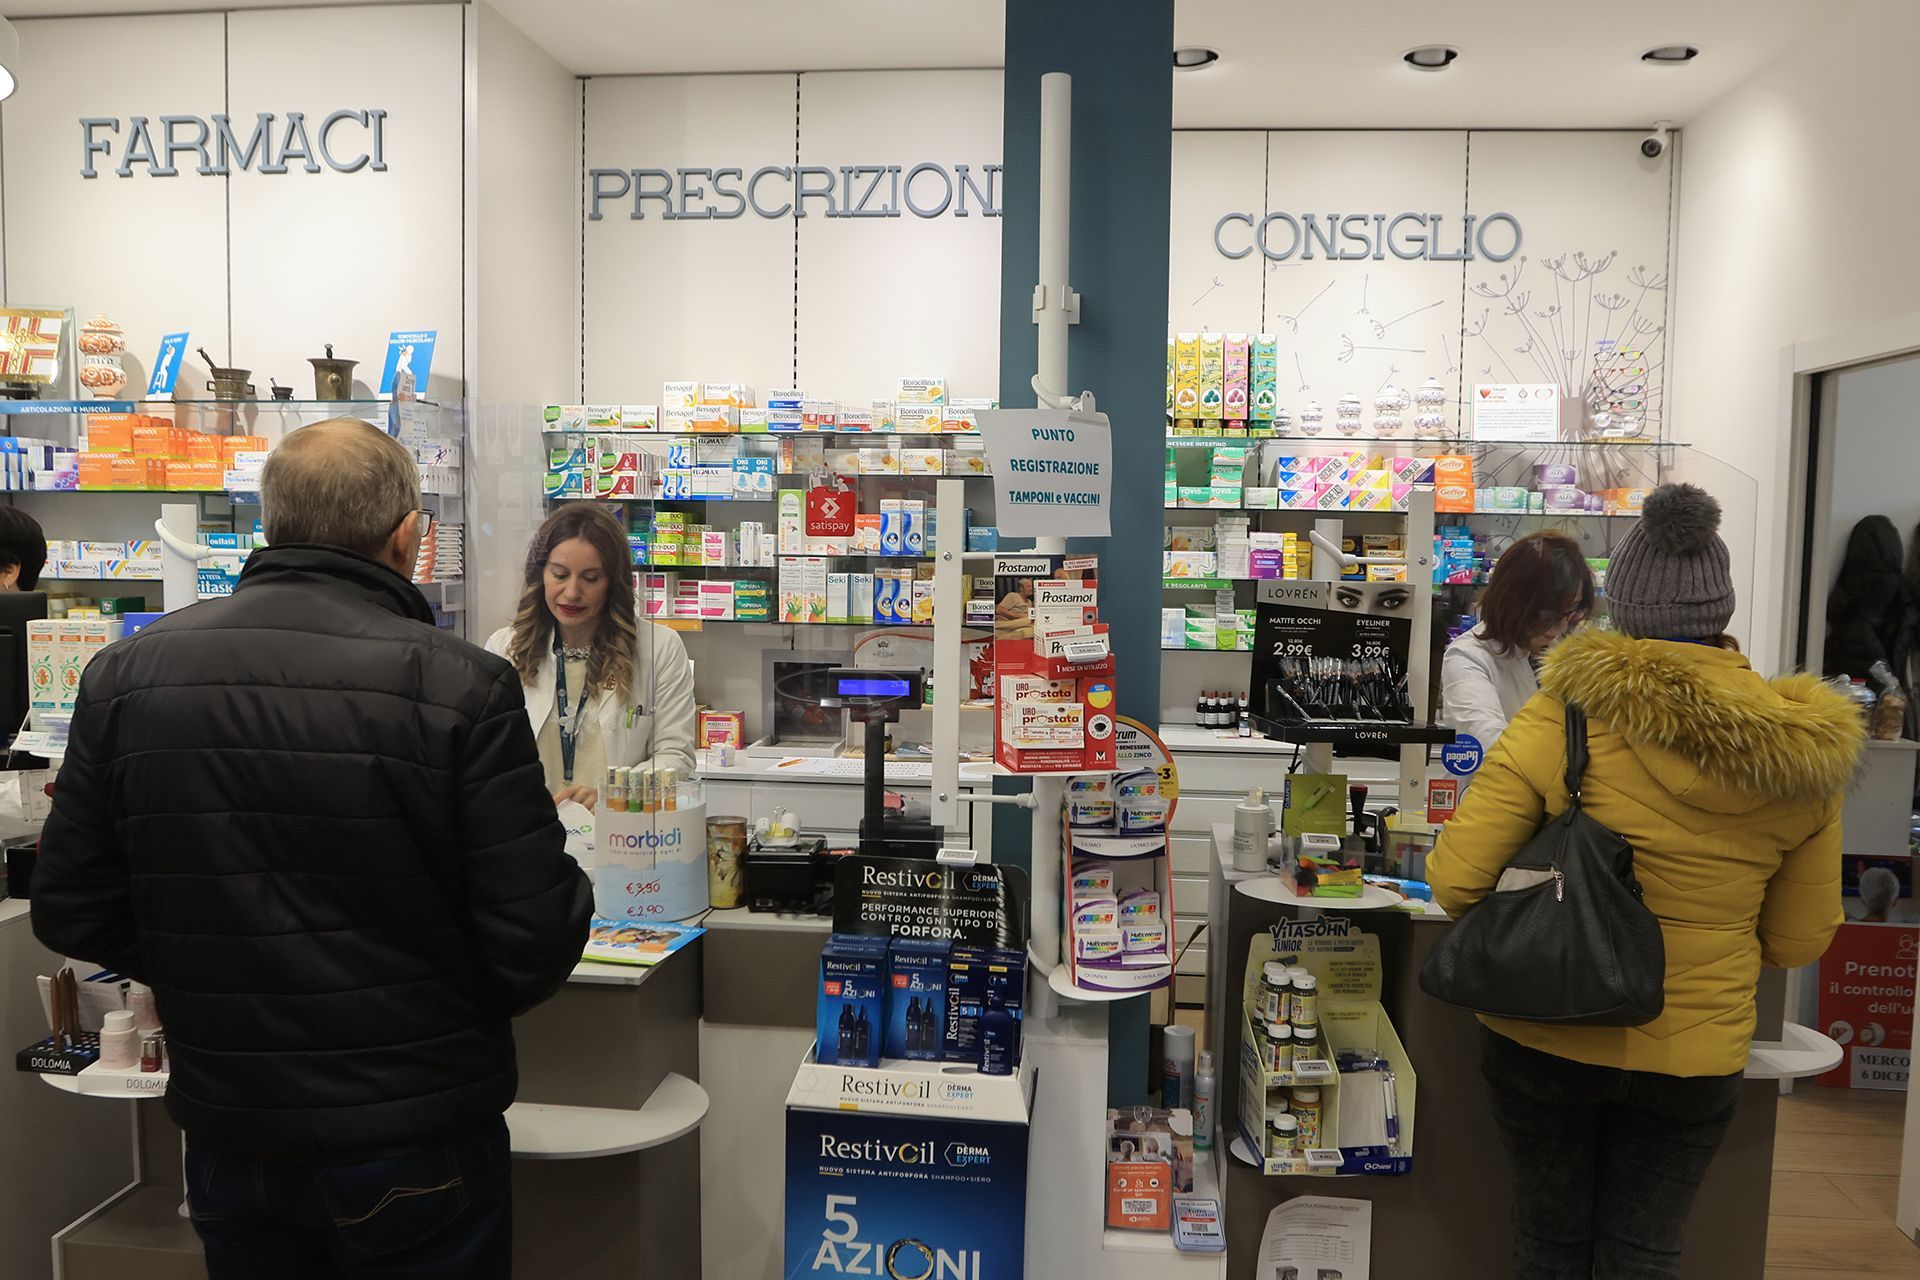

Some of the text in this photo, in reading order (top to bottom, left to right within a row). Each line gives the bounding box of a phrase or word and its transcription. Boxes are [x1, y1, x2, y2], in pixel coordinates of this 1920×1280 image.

[80, 109, 388, 178] FARMACI
[588, 162, 1003, 220] PRESCRIZION
[1213, 209, 1525, 262] CONSIGLIO
[587, 406, 613, 414] Benagol
[1032, 428, 1075, 442] PUNTO
[1010, 459, 1100, 475] REGISTRAZIONE
[1438, 460, 1464, 469] Geffer
[1009, 491, 1100, 505] TAMPONI e VACCINI
[1441, 487, 1466, 497] Geffer
[810, 520, 850, 533] satispay
[998, 561, 1047, 573] Prostamol
[828, 575, 847, 584] Seki
[854, 575, 872, 584] Seki
[198, 580, 234, 593] itask
[1042, 591, 1093, 603] Prostamol
[1273, 641, 1313, 658] 2,99€
[1351, 643, 1390, 659] 3,99€
[1016, 683, 1029, 691] URO
[1023, 707, 1036, 715] URO
[1446, 751, 1478, 762] pagoPA
[1431, 780, 1456, 789] satispay
[609, 828, 681, 849] morbidi
[861, 903, 998, 919] PERFORMANCE SUPERIORI
[861, 912, 998, 929] CONTRO OGNI TIPO DI
[891, 924, 967, 940] FORFORA.
[1845, 961, 1915, 978] Prenot
[912, 973, 920, 983] 5
[845, 980, 853, 990] 5
[1830, 982, 1913, 997] il controllo
[31, 1057, 72, 1070] DOLOMIA
[1859, 1054, 1911, 1067] MERCO
[1862, 1070, 1869, 1080] 6
[946, 1091, 973, 1099] EXPERT
[956, 1155, 991, 1164] EXPERT
[819, 1165, 844, 1174] NUOVO
[846, 1167, 876, 1176] SISTEMA
[878, 1169, 929, 1180] ANTIFORFORA
[822, 1193, 859, 1244] 5
[811, 1238, 981, 1280] AZIONI
